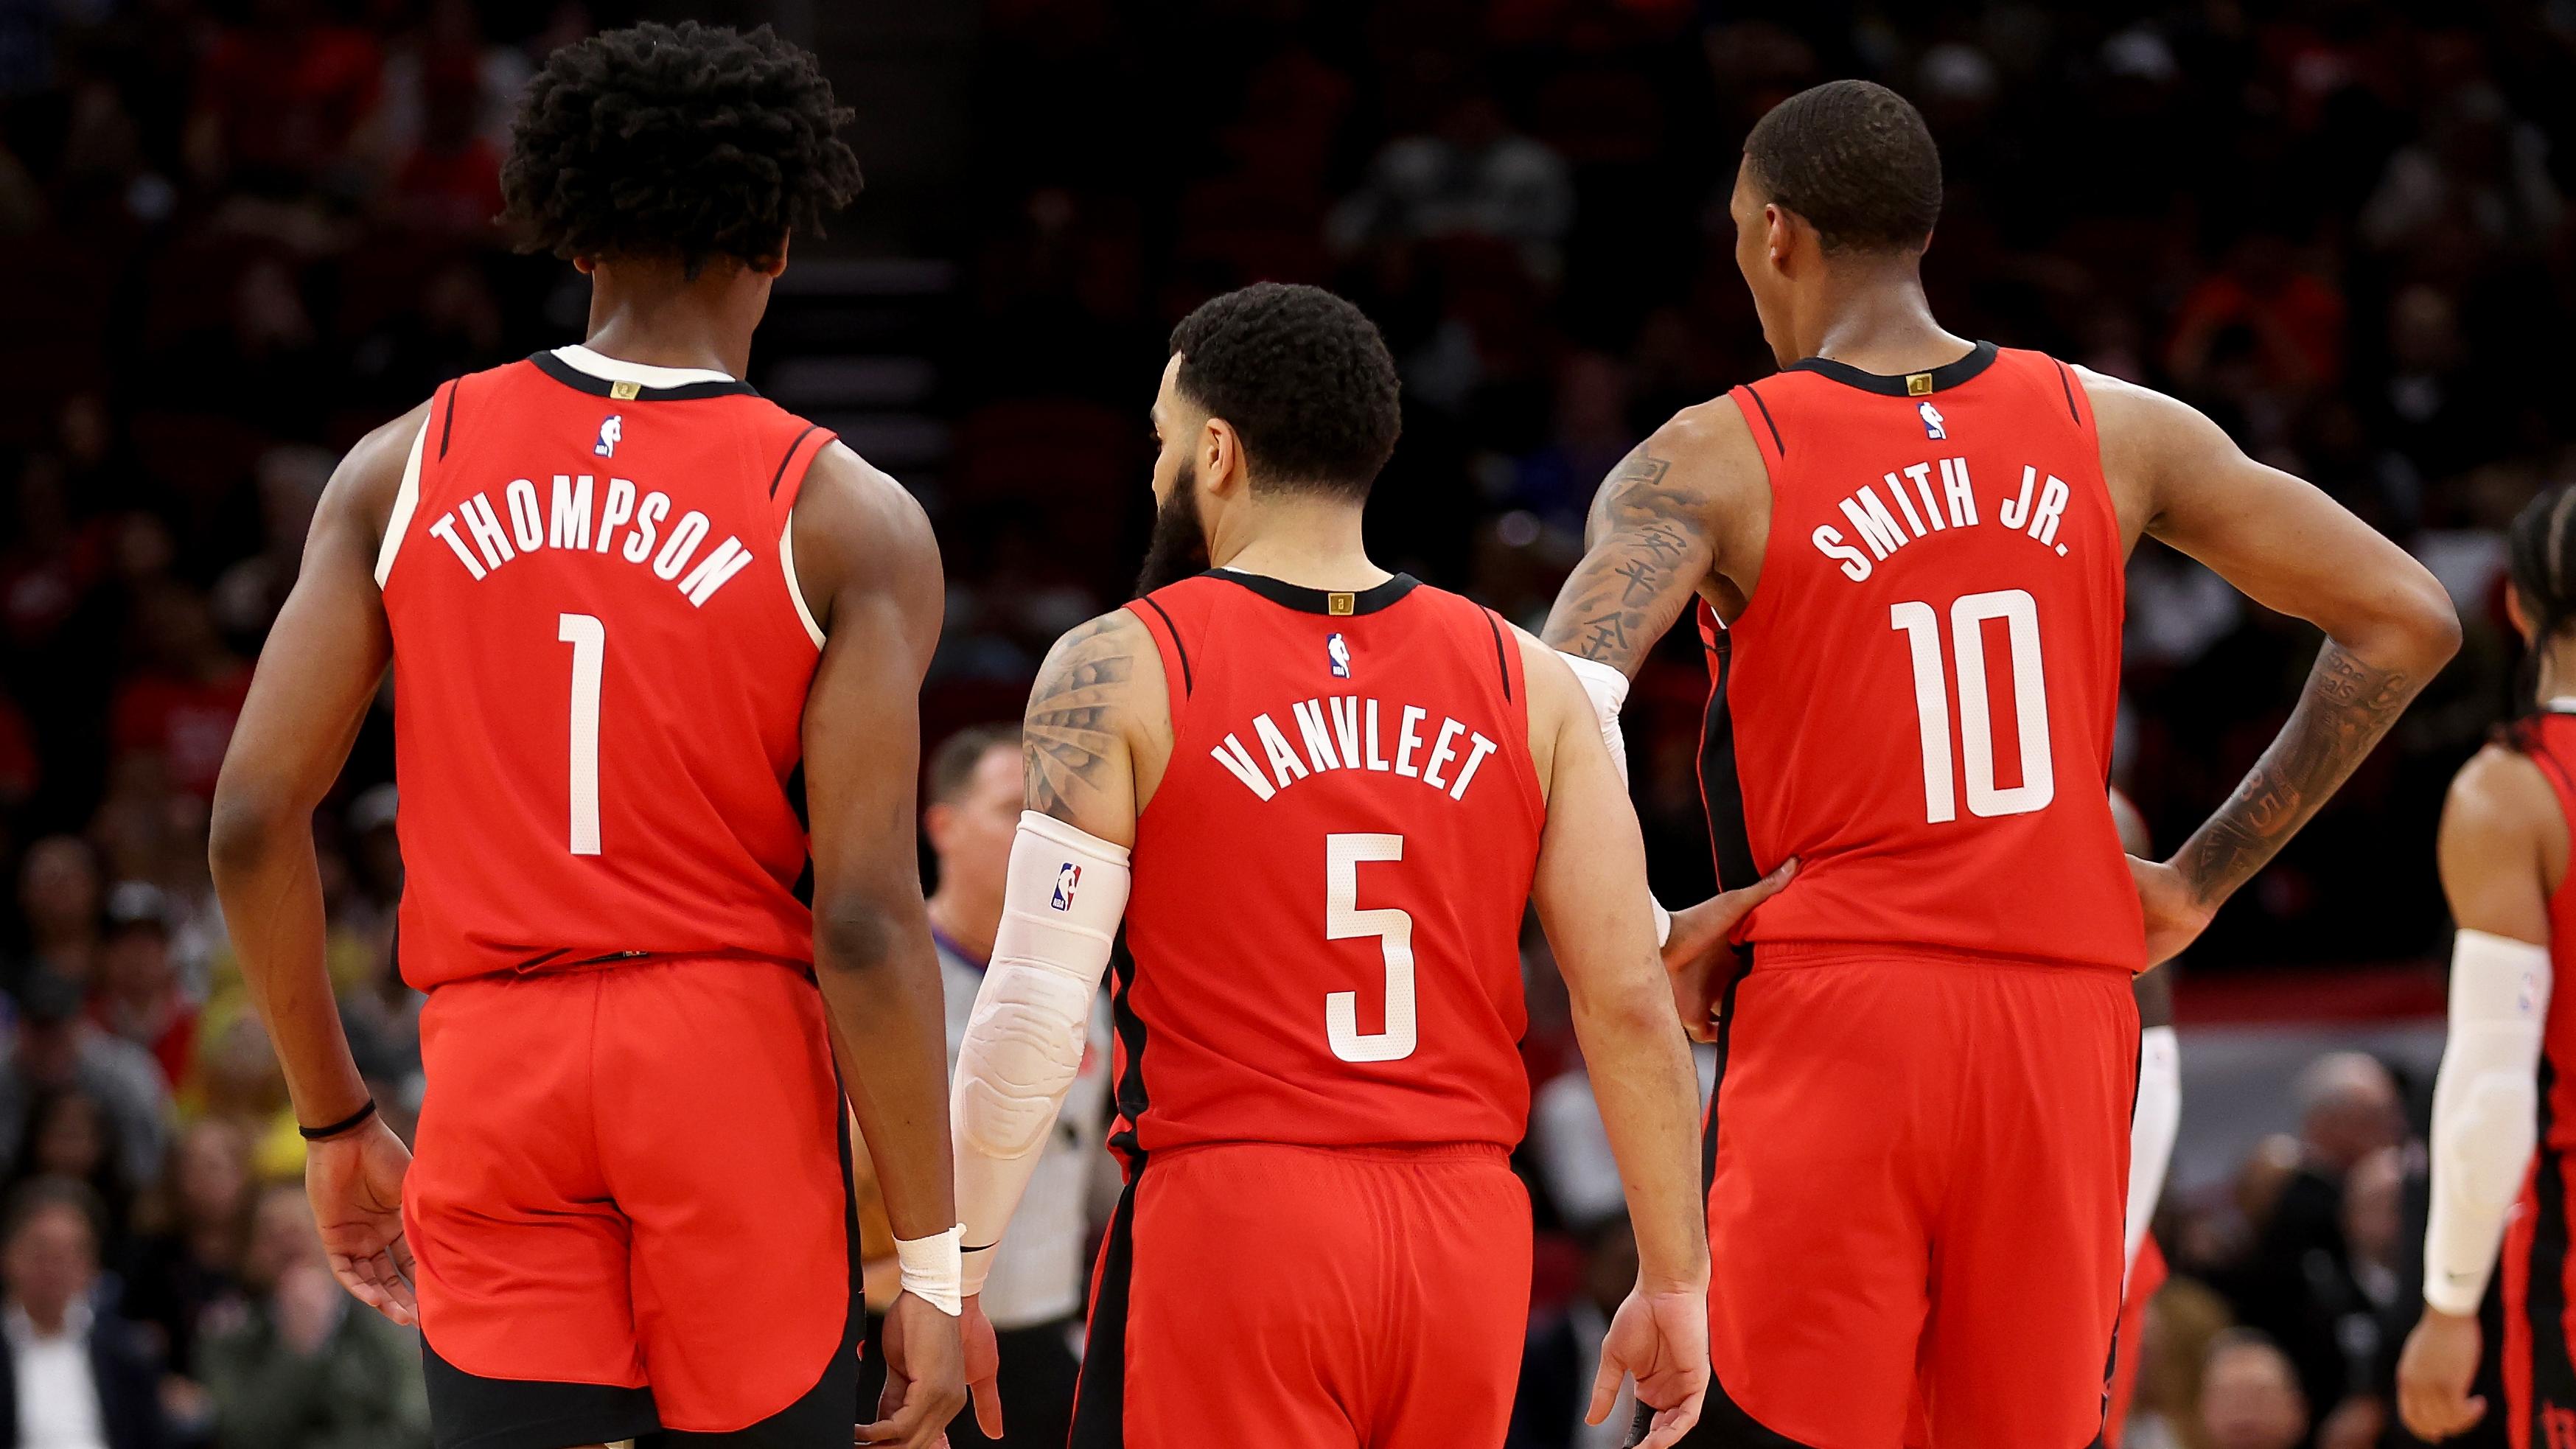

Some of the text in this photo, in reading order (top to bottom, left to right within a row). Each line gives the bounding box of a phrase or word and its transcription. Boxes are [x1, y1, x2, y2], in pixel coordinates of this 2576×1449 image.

[427, 474, 754, 609] THOMPSON
[1810, 456, 2070, 583] SMITH JR.
[557, 612, 606, 856] 1
[1210, 695, 1498, 803] VANVLEET
[1890, 588, 2056, 824] 10
[1325, 832, 1418, 1064] 5
